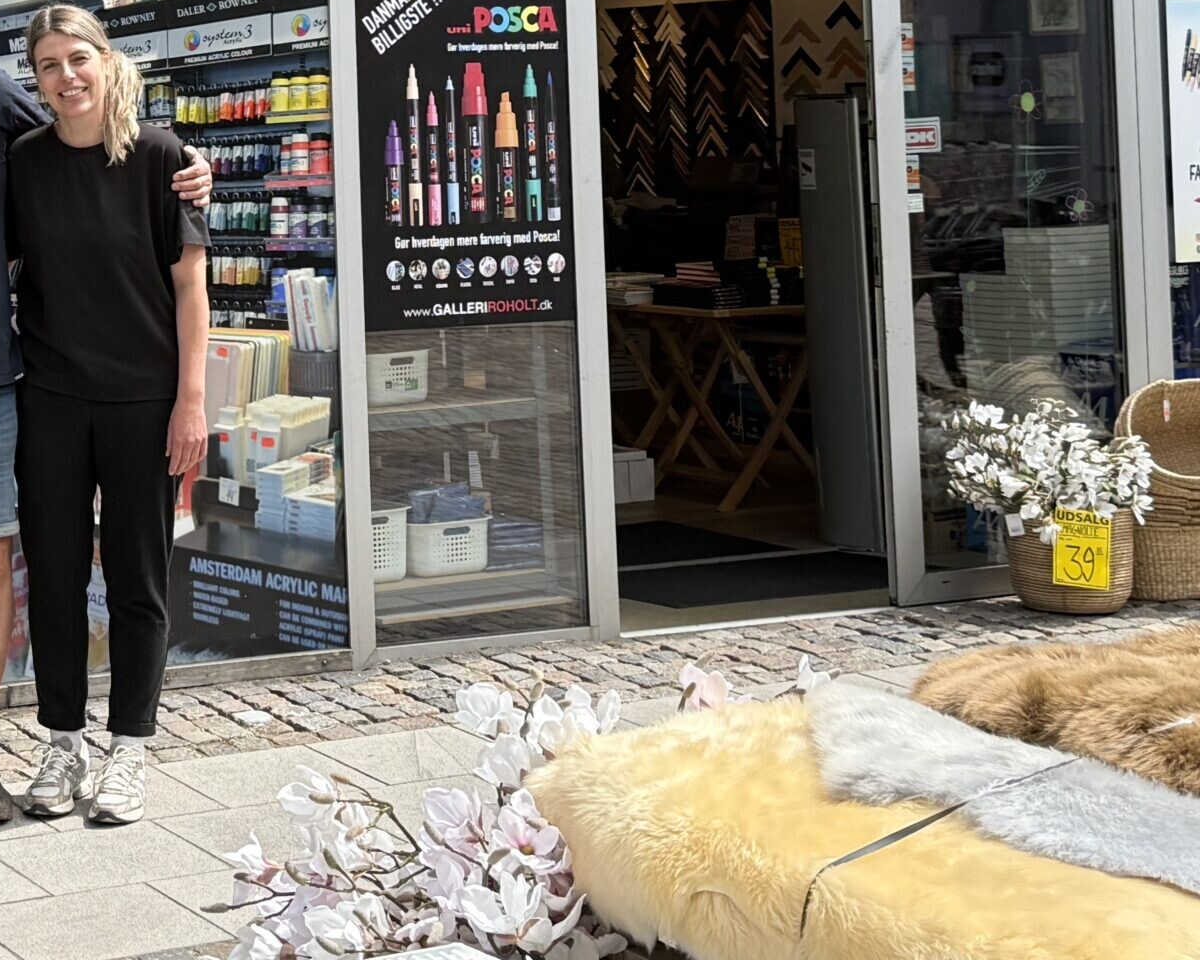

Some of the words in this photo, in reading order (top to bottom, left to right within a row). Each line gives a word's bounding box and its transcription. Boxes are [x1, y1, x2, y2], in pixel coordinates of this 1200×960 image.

[121, 12, 156, 26] ROWNEY
[177, 5, 206, 18] DALER
[447, 23, 472, 34] uni
[473, 5, 558, 33] POSCA
[458, 41, 488, 53] hverdagen
[470, 149, 482, 194] POSCA
[503, 169, 513, 204] POSCA
[395, 237, 409, 249] Gør
[411, 235, 455, 250] hverdagen
[456, 236, 478, 246] mere
[480, 233, 511, 247] farverig
[513, 231, 532, 243] med
[533, 229, 560, 243] Posca!
[403, 298, 553, 318] www.GALLERIROHOLT.dk
[1056, 510, 1109, 526] UDSALG
[1063, 544, 1095, 583] 39
[190, 556, 262, 587] AMSTERDAM
[265, 571, 318, 599] ACRYLIC
